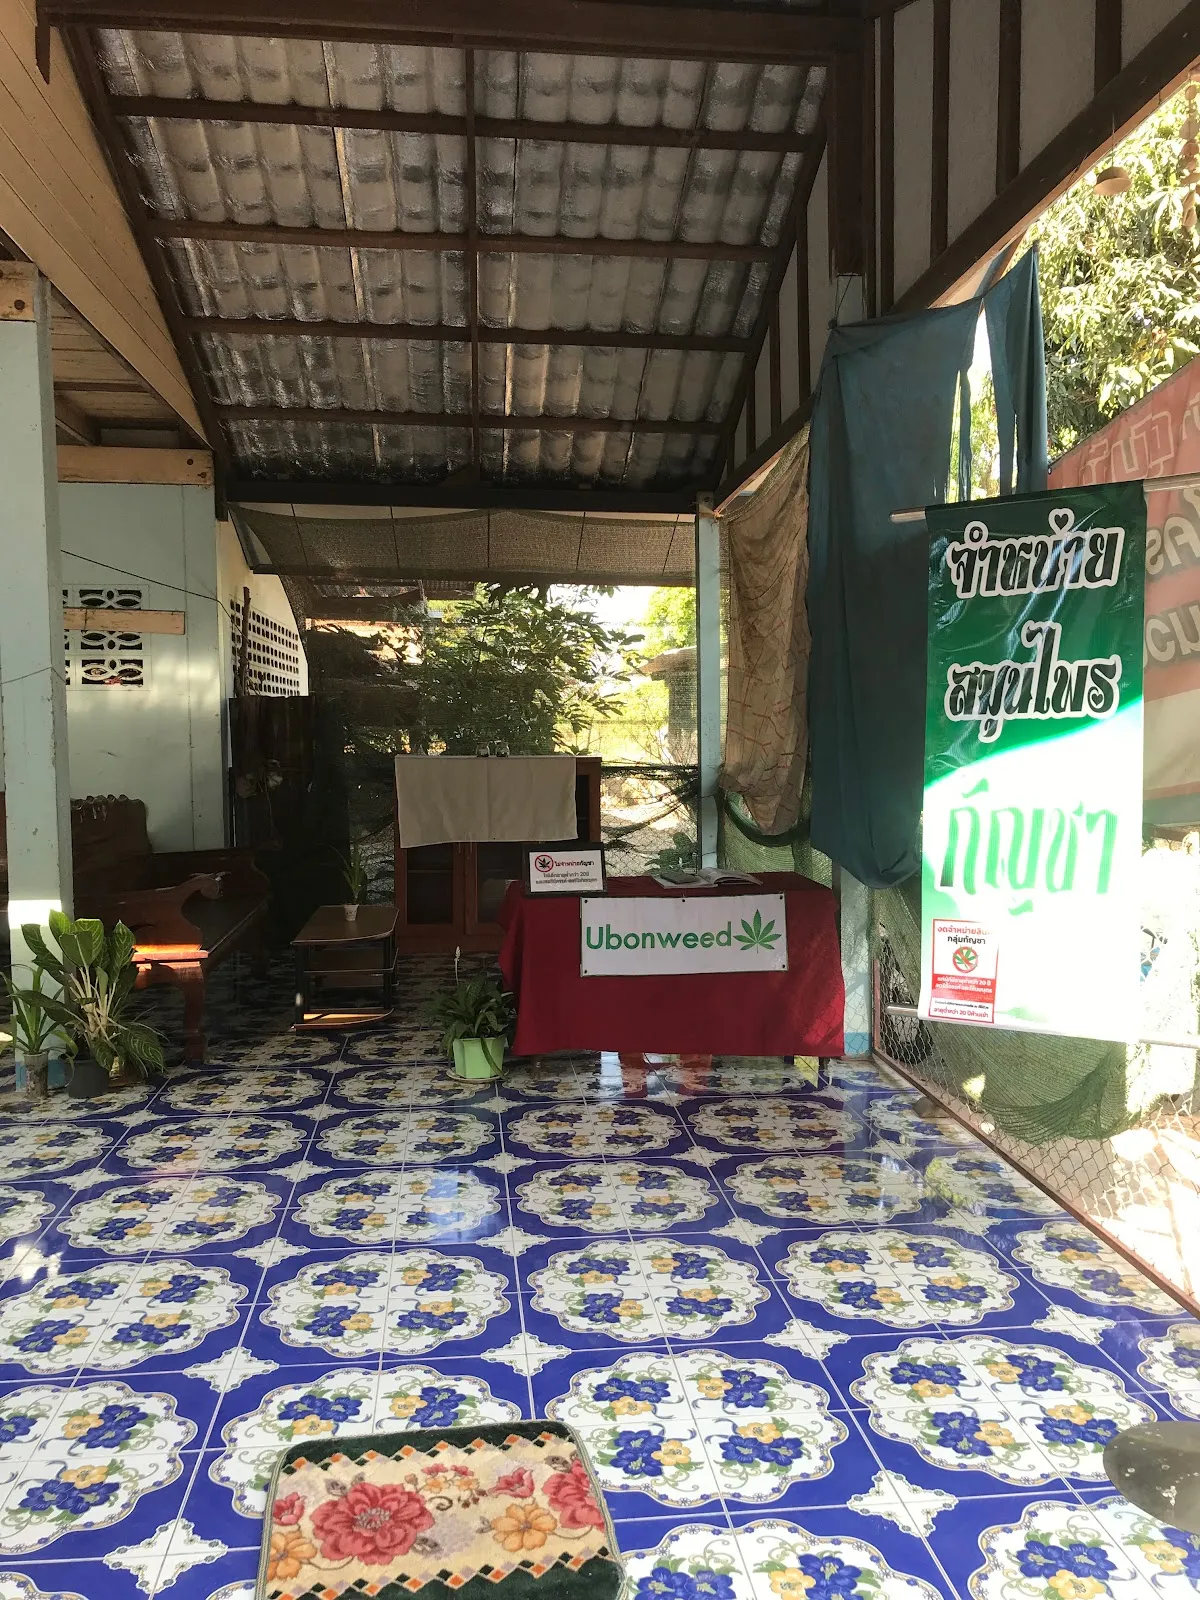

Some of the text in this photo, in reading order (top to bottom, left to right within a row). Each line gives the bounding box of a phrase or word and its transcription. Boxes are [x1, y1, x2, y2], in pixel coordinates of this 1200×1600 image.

[946, 509, 1124, 598] จำหน่าย
[944, 621, 1122, 742] สมุนไพร
[940, 778, 1118, 916] กัญชา
[586, 921, 732, 950] Ubonweed
[947, 935, 986, 945] กลุ่มกัญชา
